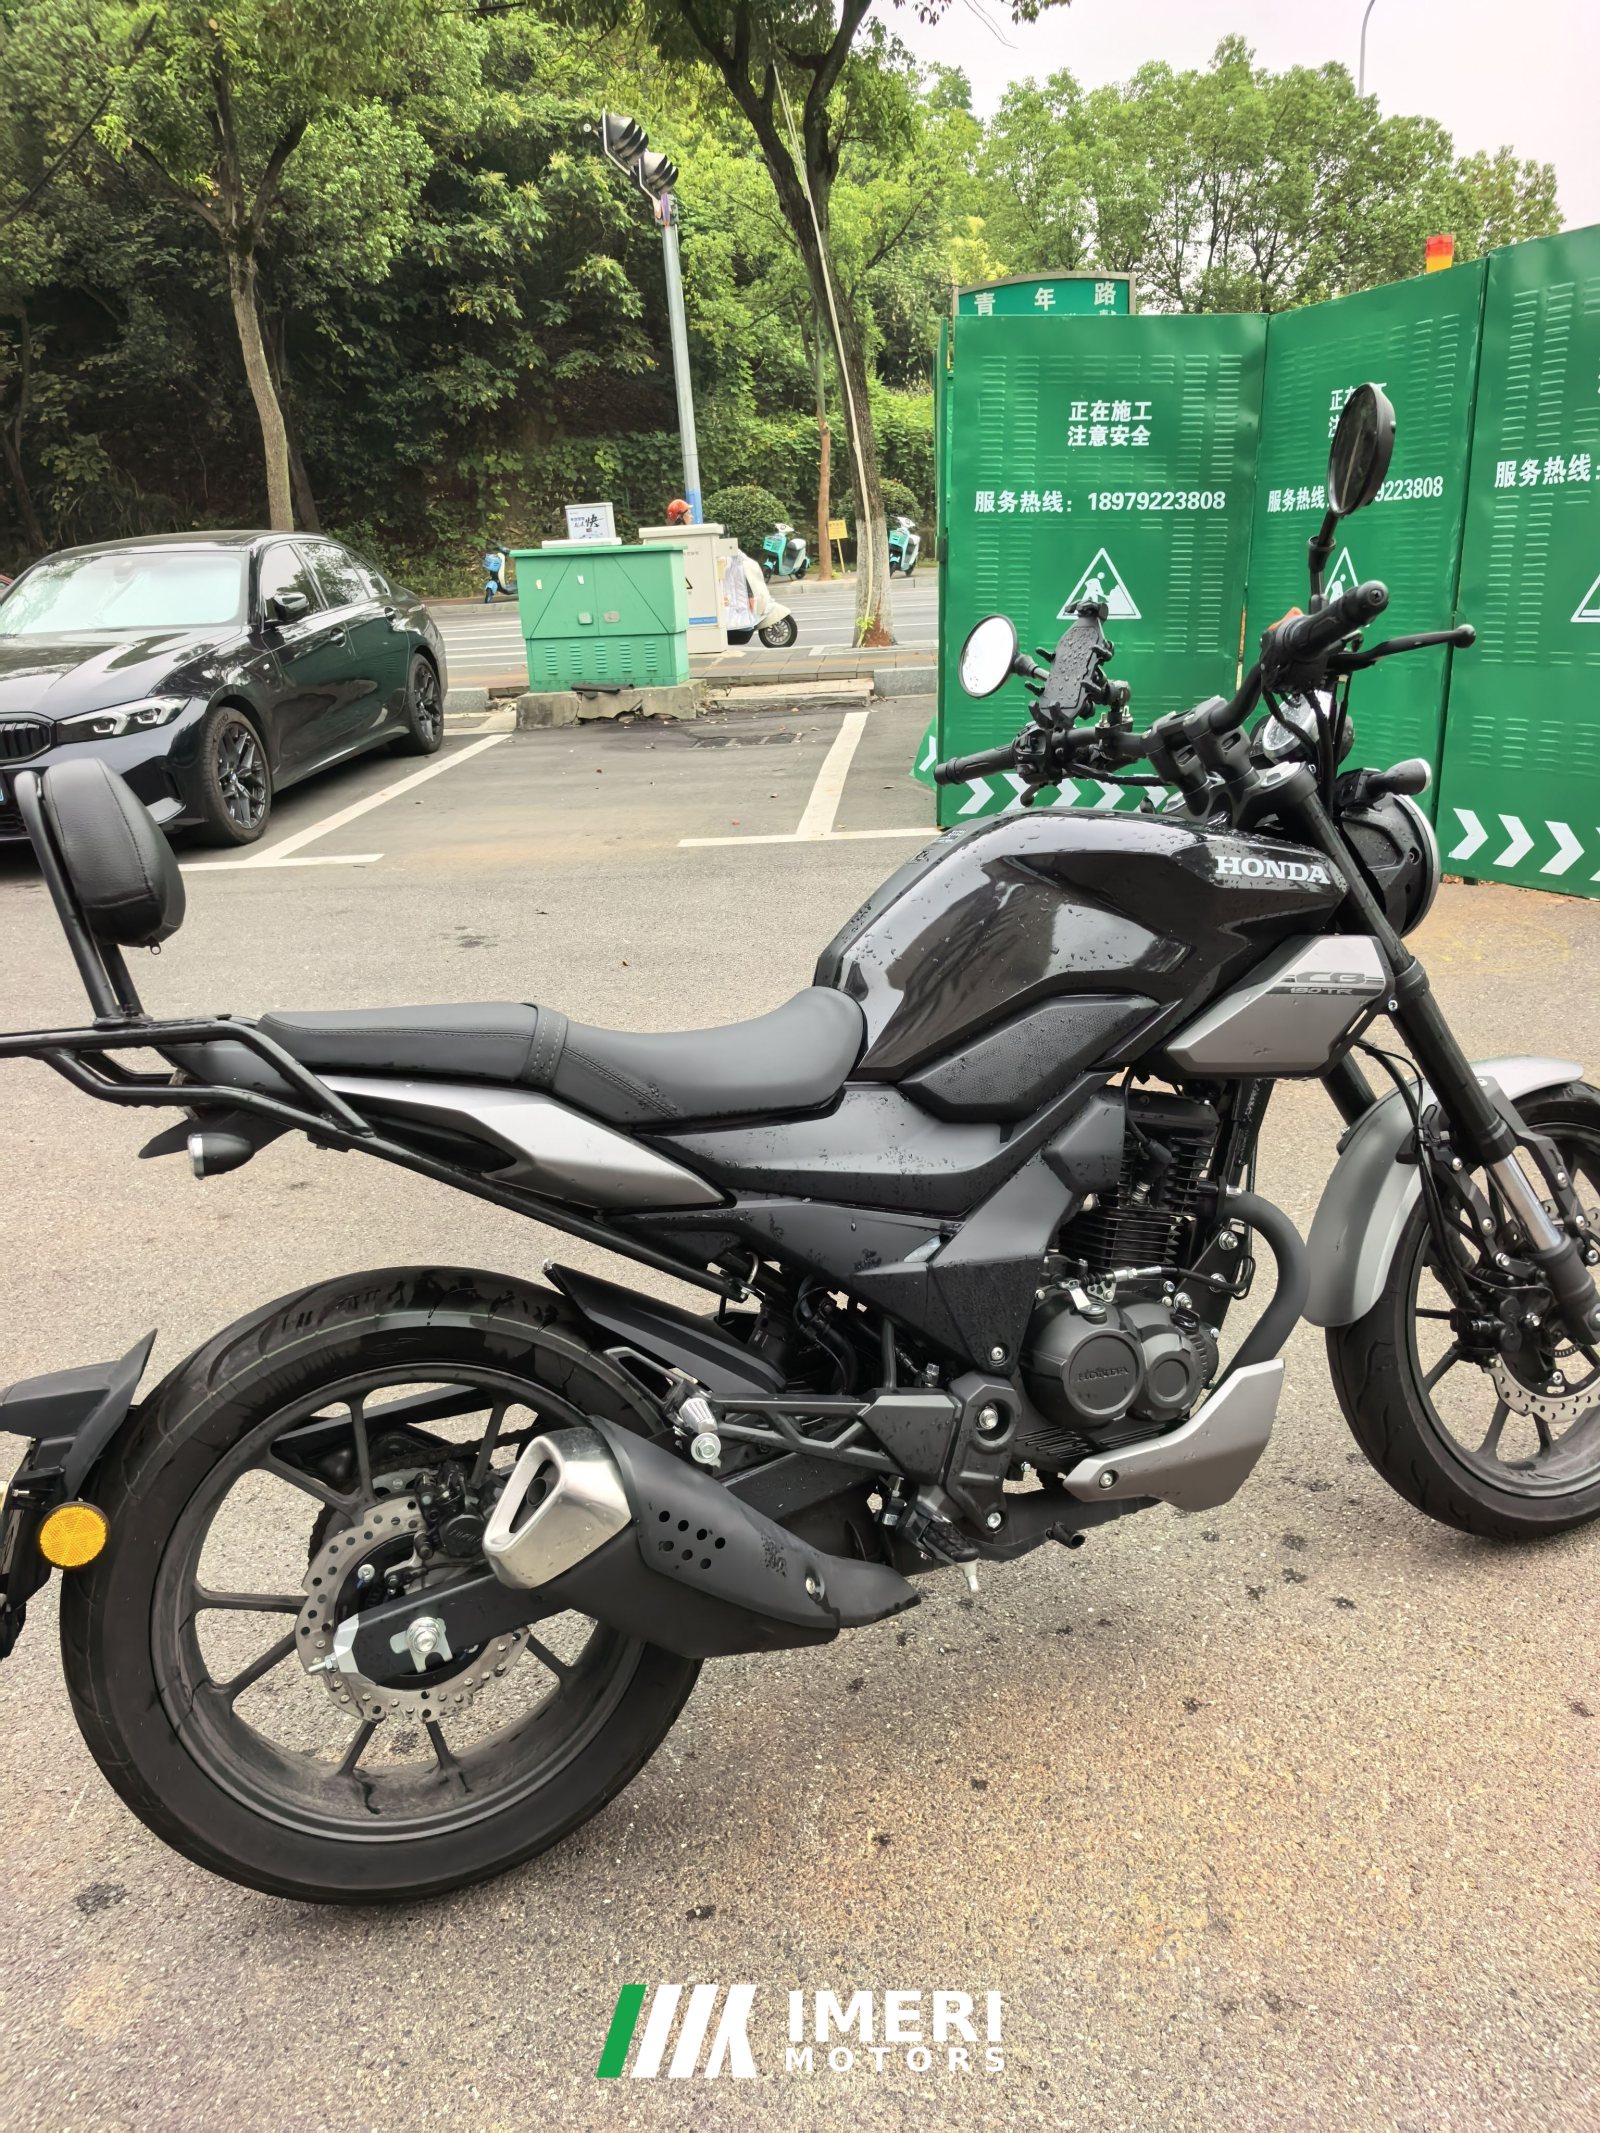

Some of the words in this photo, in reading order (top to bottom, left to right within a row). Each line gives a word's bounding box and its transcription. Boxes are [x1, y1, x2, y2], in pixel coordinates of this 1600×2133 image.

[974, 281, 1116, 316] 青年路
[1068, 400, 1152, 422] 正在施工
[1067, 424, 1151, 446] 注意安全
[974, 490, 1072, 513] 服务热线：
[1087, 491, 1226, 511] 18979223808
[1215, 855, 1331, 885] HONDA
[1295, 971, 1366, 985] CB
